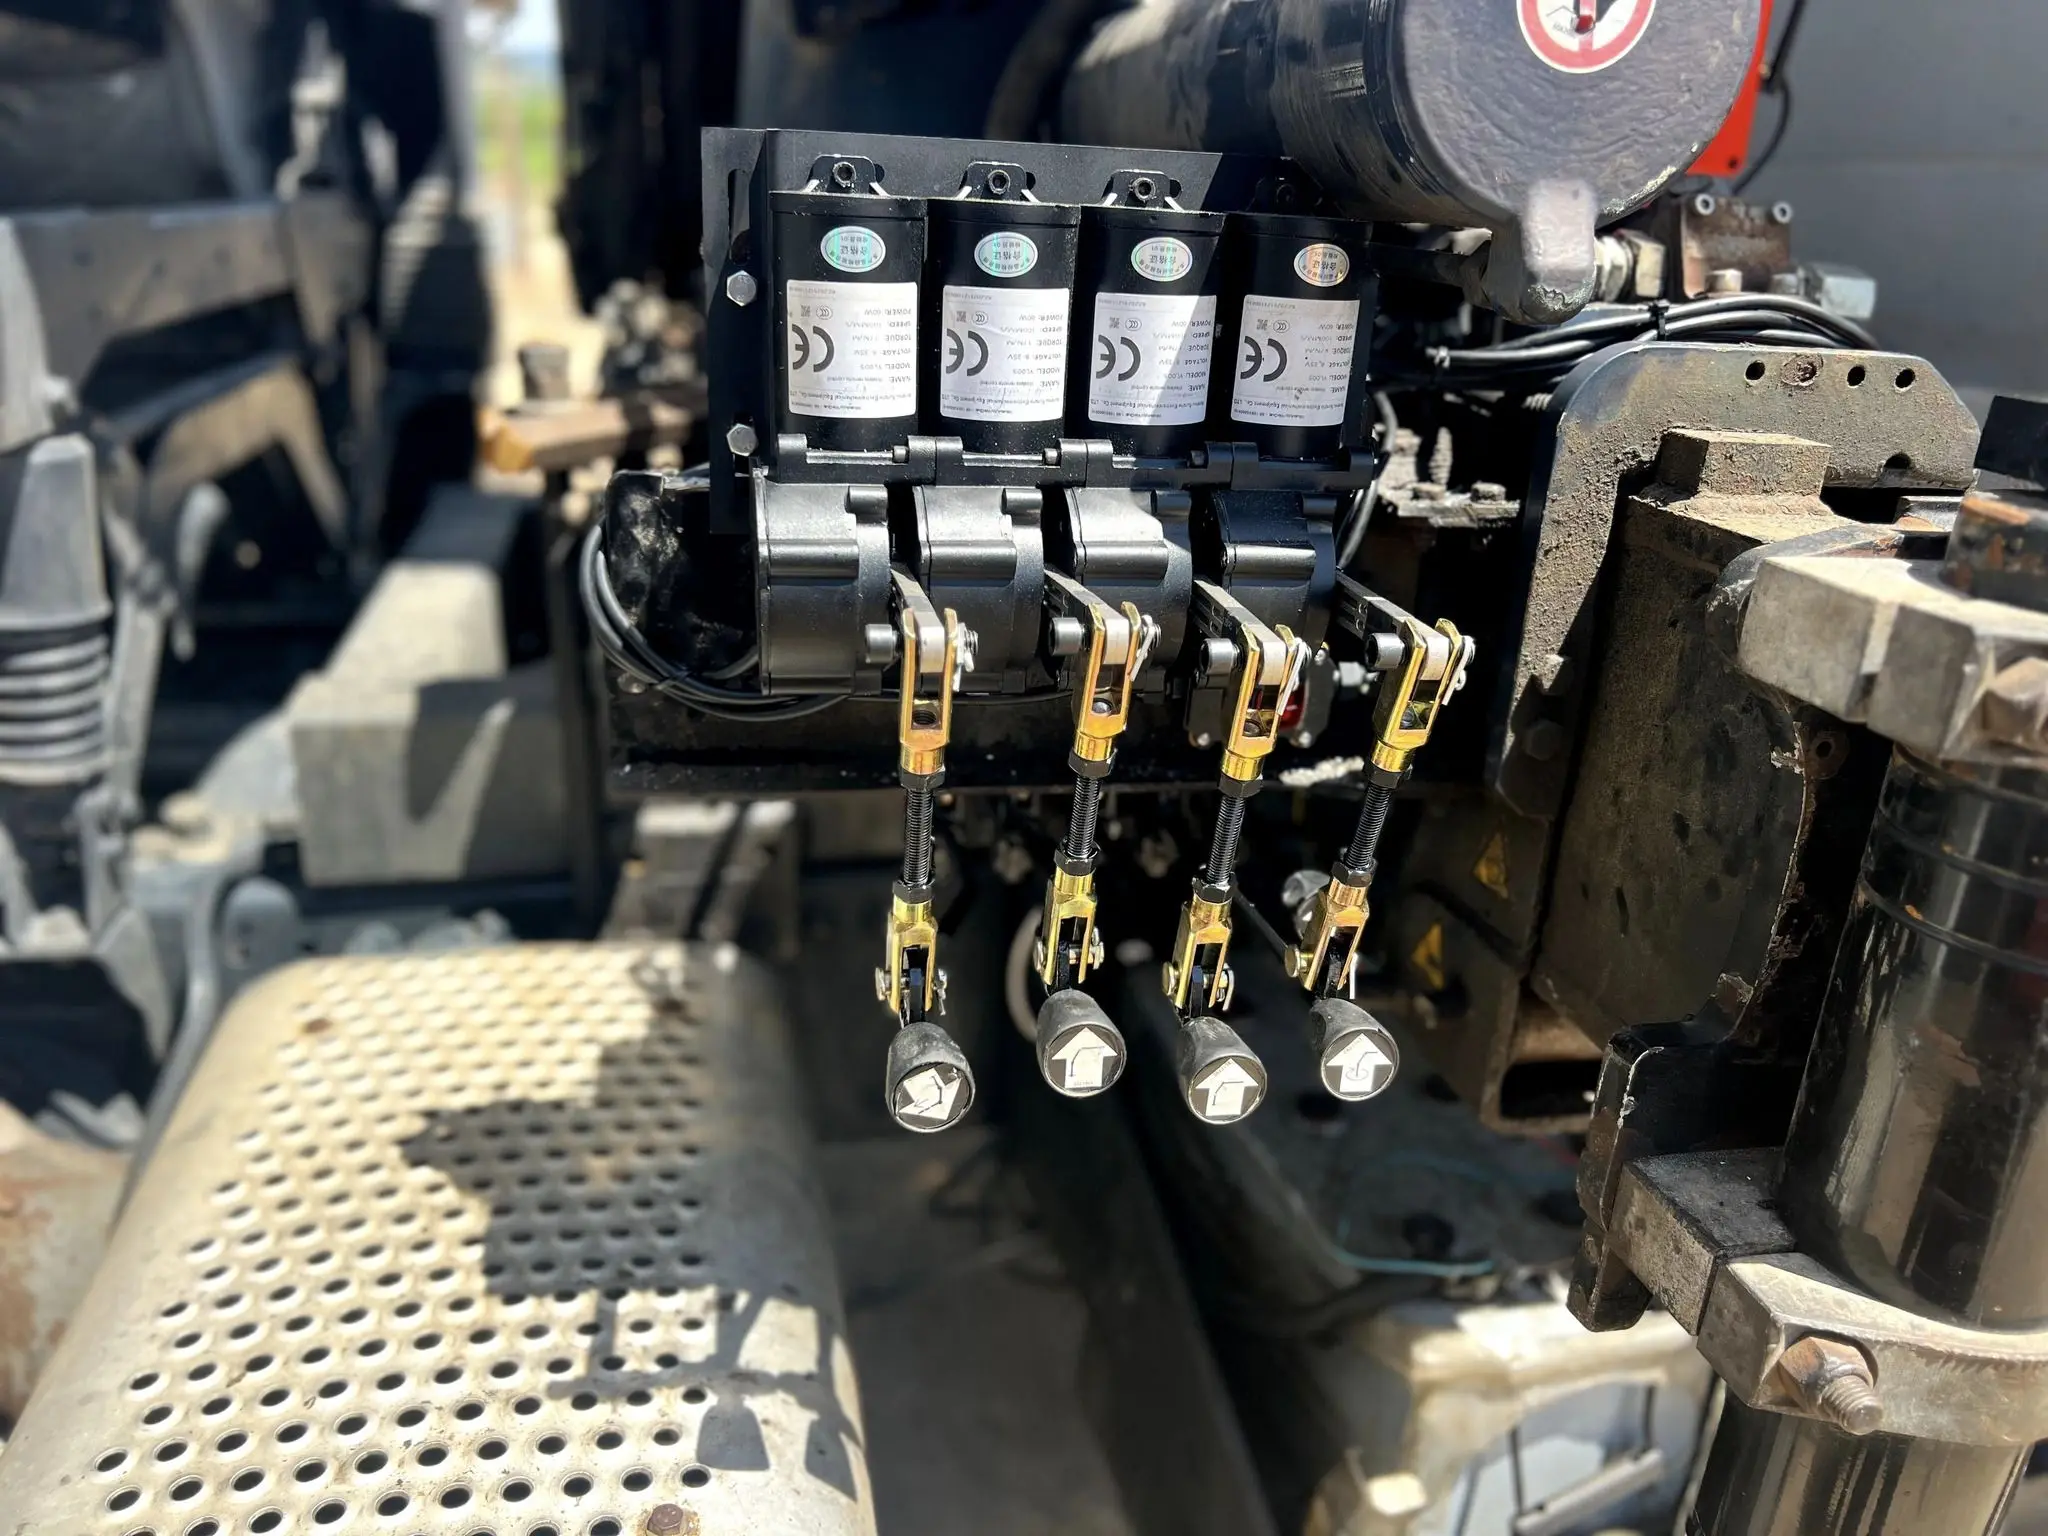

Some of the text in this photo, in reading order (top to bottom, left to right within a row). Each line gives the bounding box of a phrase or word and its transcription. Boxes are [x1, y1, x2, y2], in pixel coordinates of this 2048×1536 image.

[840, 246, 868, 255] 合格证
[994, 251, 1021, 260] 合格证
[1149, 255, 1176, 264] 合格证
[1313, 261, 1336, 270] 合格证
[792, 324, 834, 372] CE
[946, 328, 988, 376] CE
[1096, 334, 1140, 381] CE
[1240, 336, 1287, 382] CE
[1253, 400, 1280, 408] Equipment
